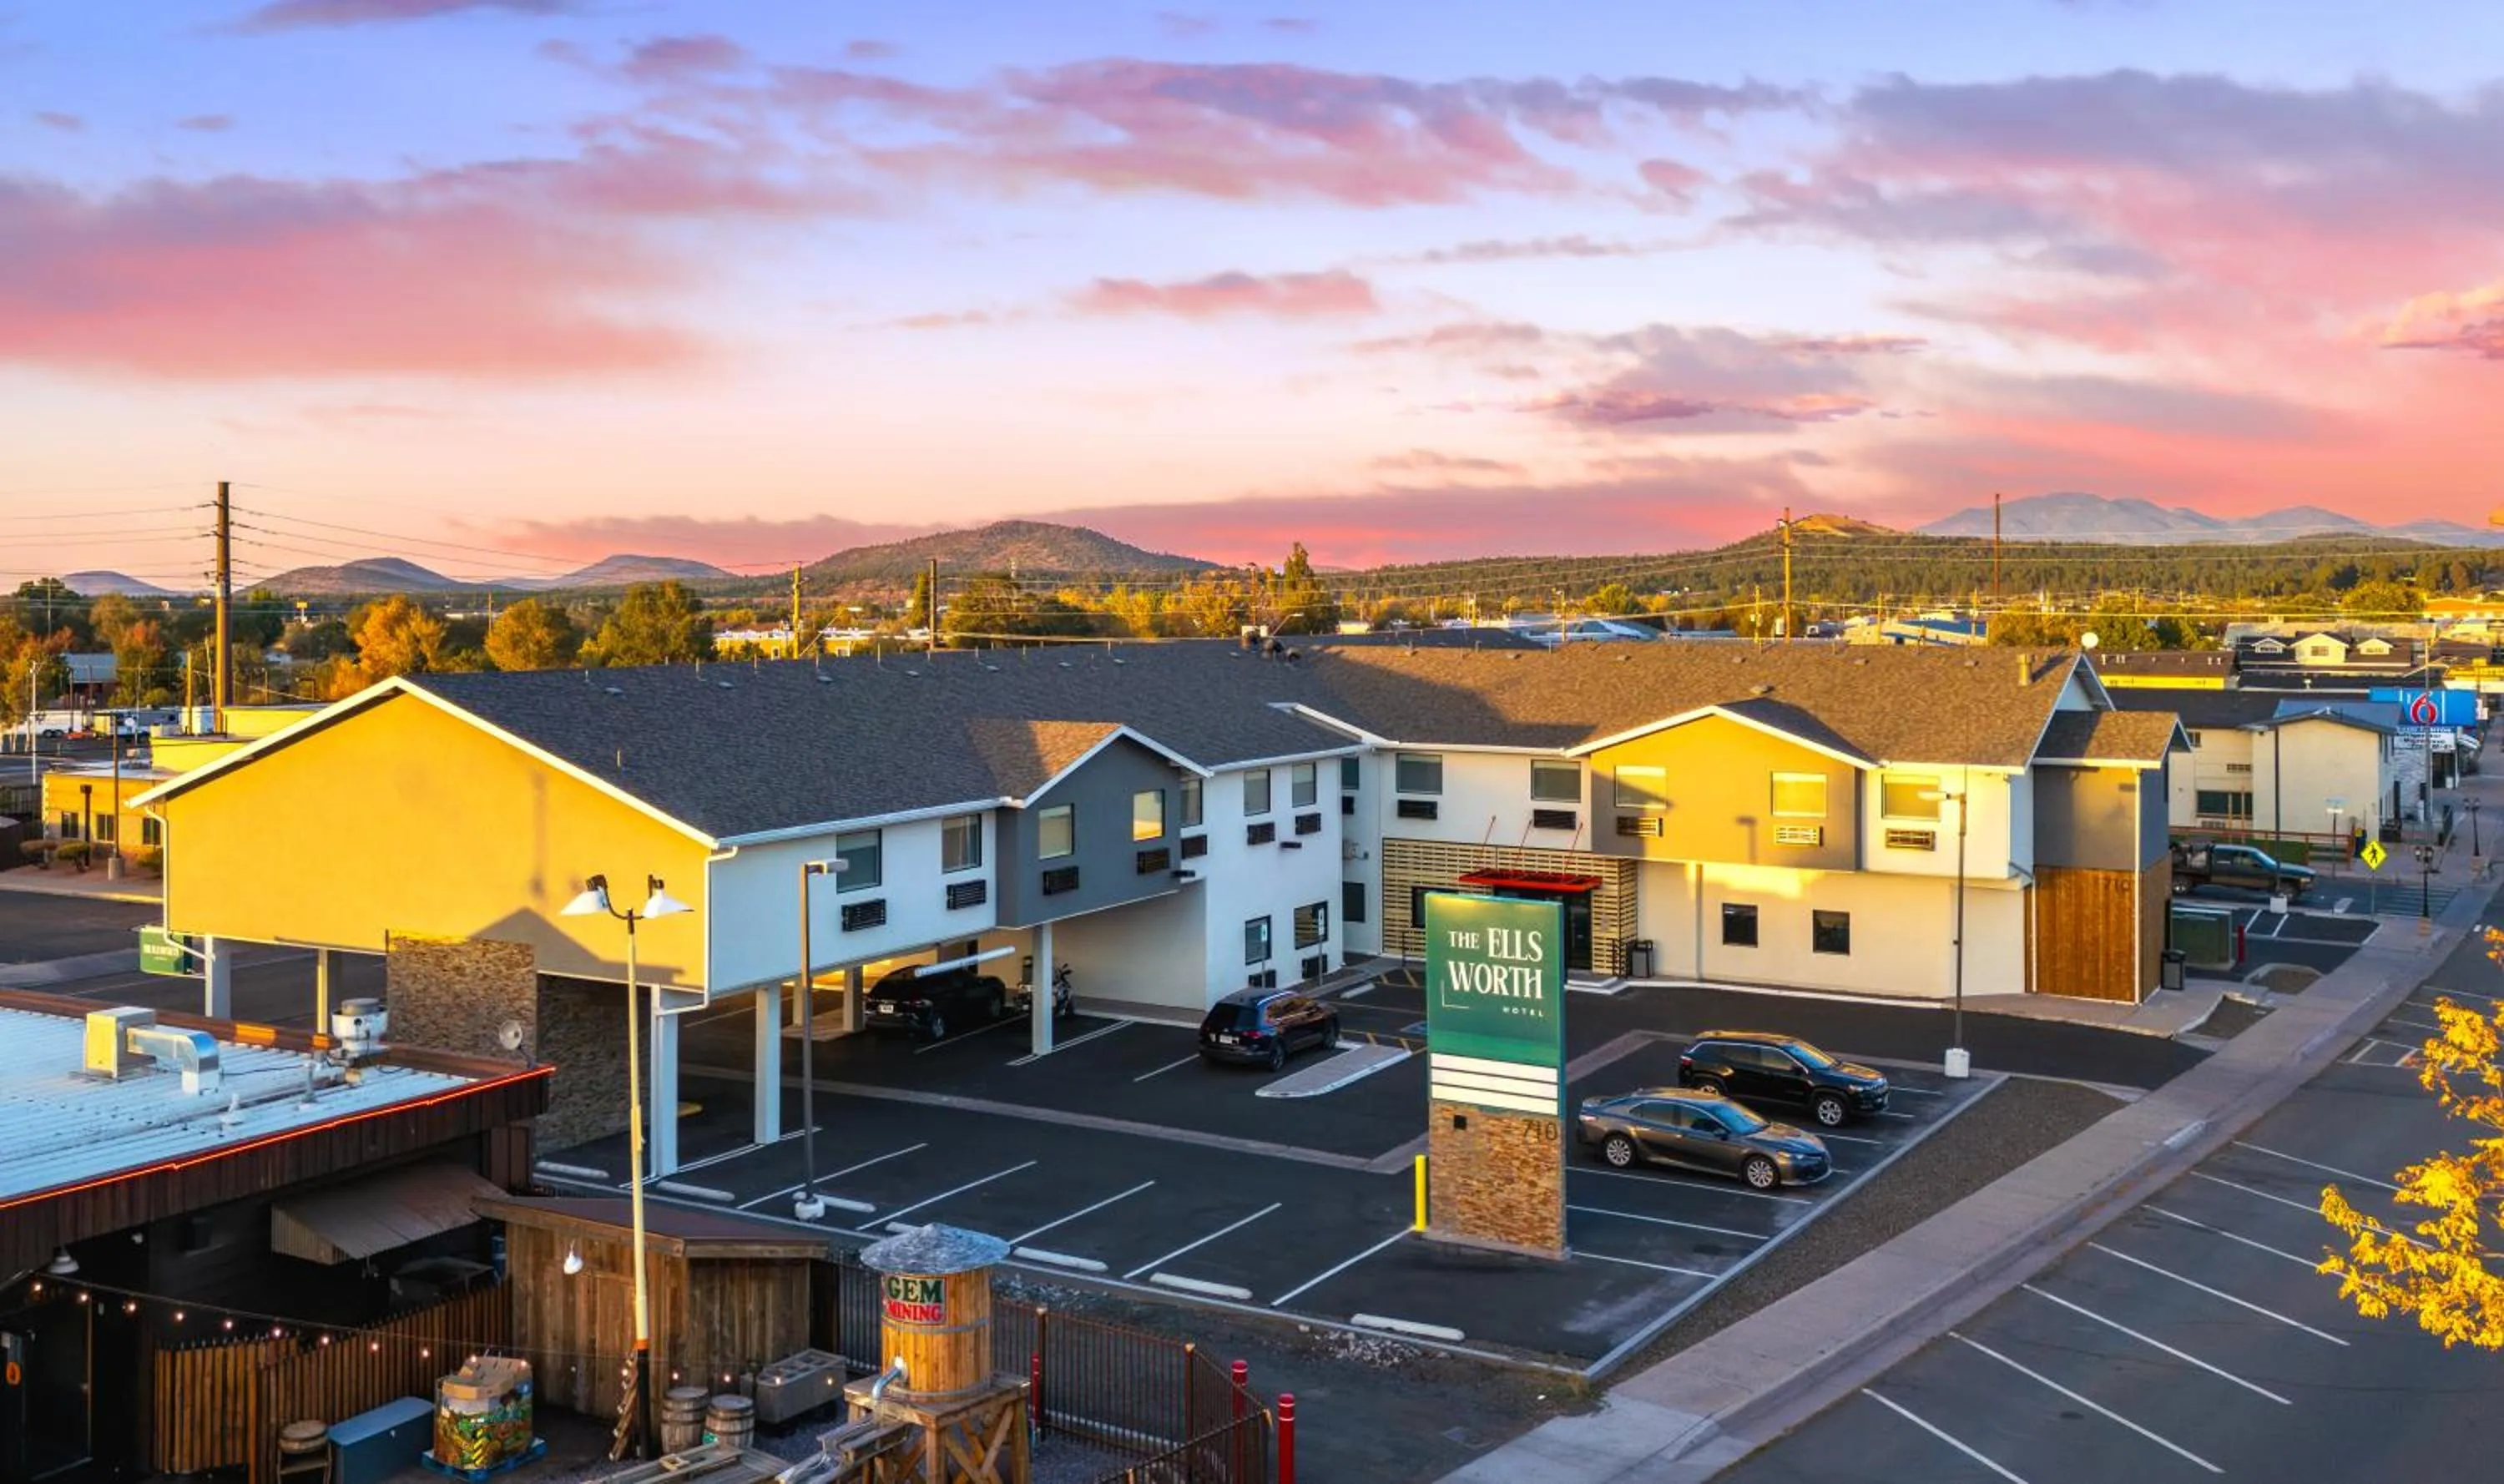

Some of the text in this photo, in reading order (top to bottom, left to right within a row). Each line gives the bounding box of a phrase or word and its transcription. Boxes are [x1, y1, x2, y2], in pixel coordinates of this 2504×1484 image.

[2410, 692, 2438, 725] 6
[1448, 927, 1543, 962] THE ELLS
[1447, 960, 1543, 999] WORTH
[1502, 1007, 1544, 1017] HOTEL
[1522, 1118, 1558, 1142] 710
[887, 1276, 942, 1304] GEM
[887, 1300, 941, 1322] MINING
